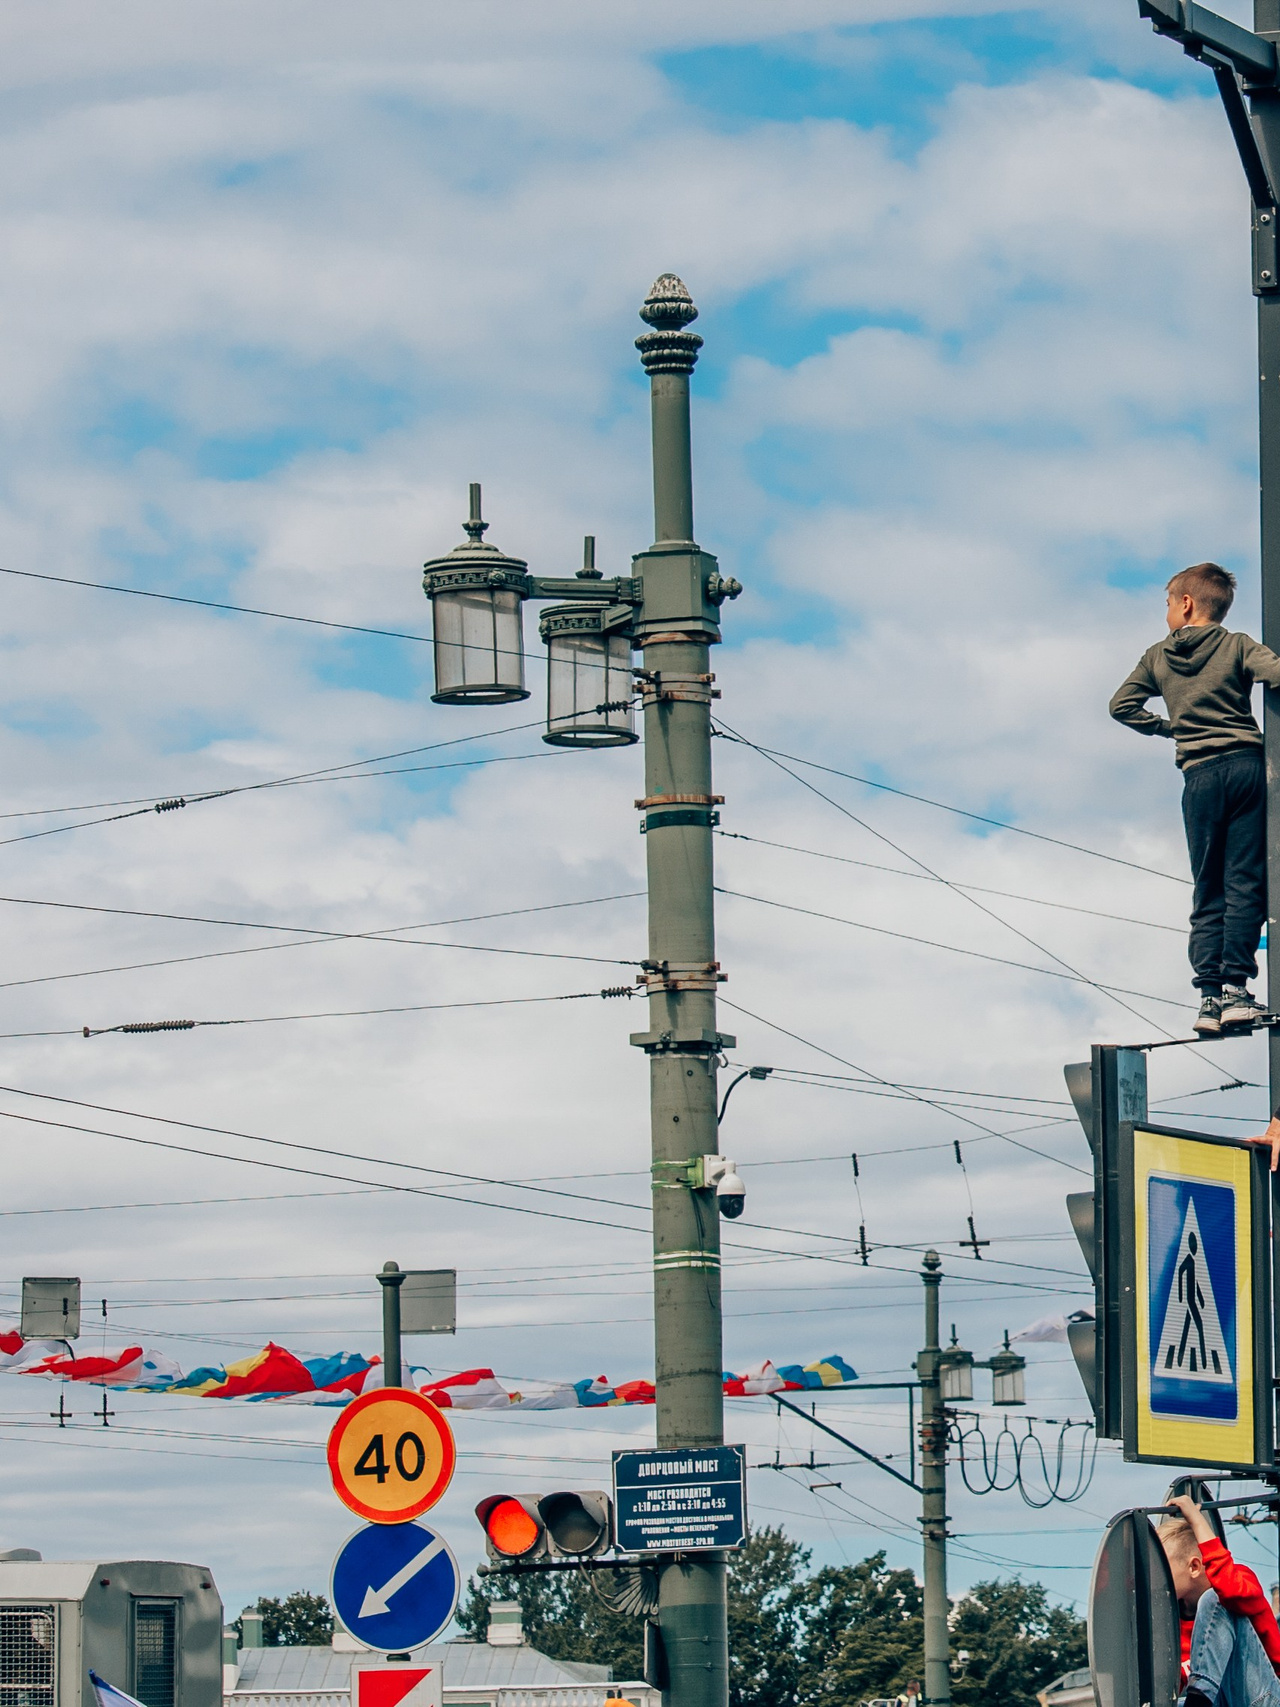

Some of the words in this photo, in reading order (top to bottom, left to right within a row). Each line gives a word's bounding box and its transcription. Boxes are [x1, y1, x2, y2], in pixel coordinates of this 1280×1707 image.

[354, 1431, 426, 1483] 40
[638, 1459, 693, 1477] ДВОРЦОВЫЙ
[694, 1459, 719, 1473] МОСТ
[647, 1489, 666, 1500] МОСТ
[666, 1487, 711, 1500] РАЗВОДИТСЯ
[638, 1502, 651, 1512] 1:10
[652, 1504, 660, 1512] до
[661, 1501, 676, 1511] 2:50
[702, 1501, 710, 1509] до
[711, 1498, 726, 1509] 4:55
